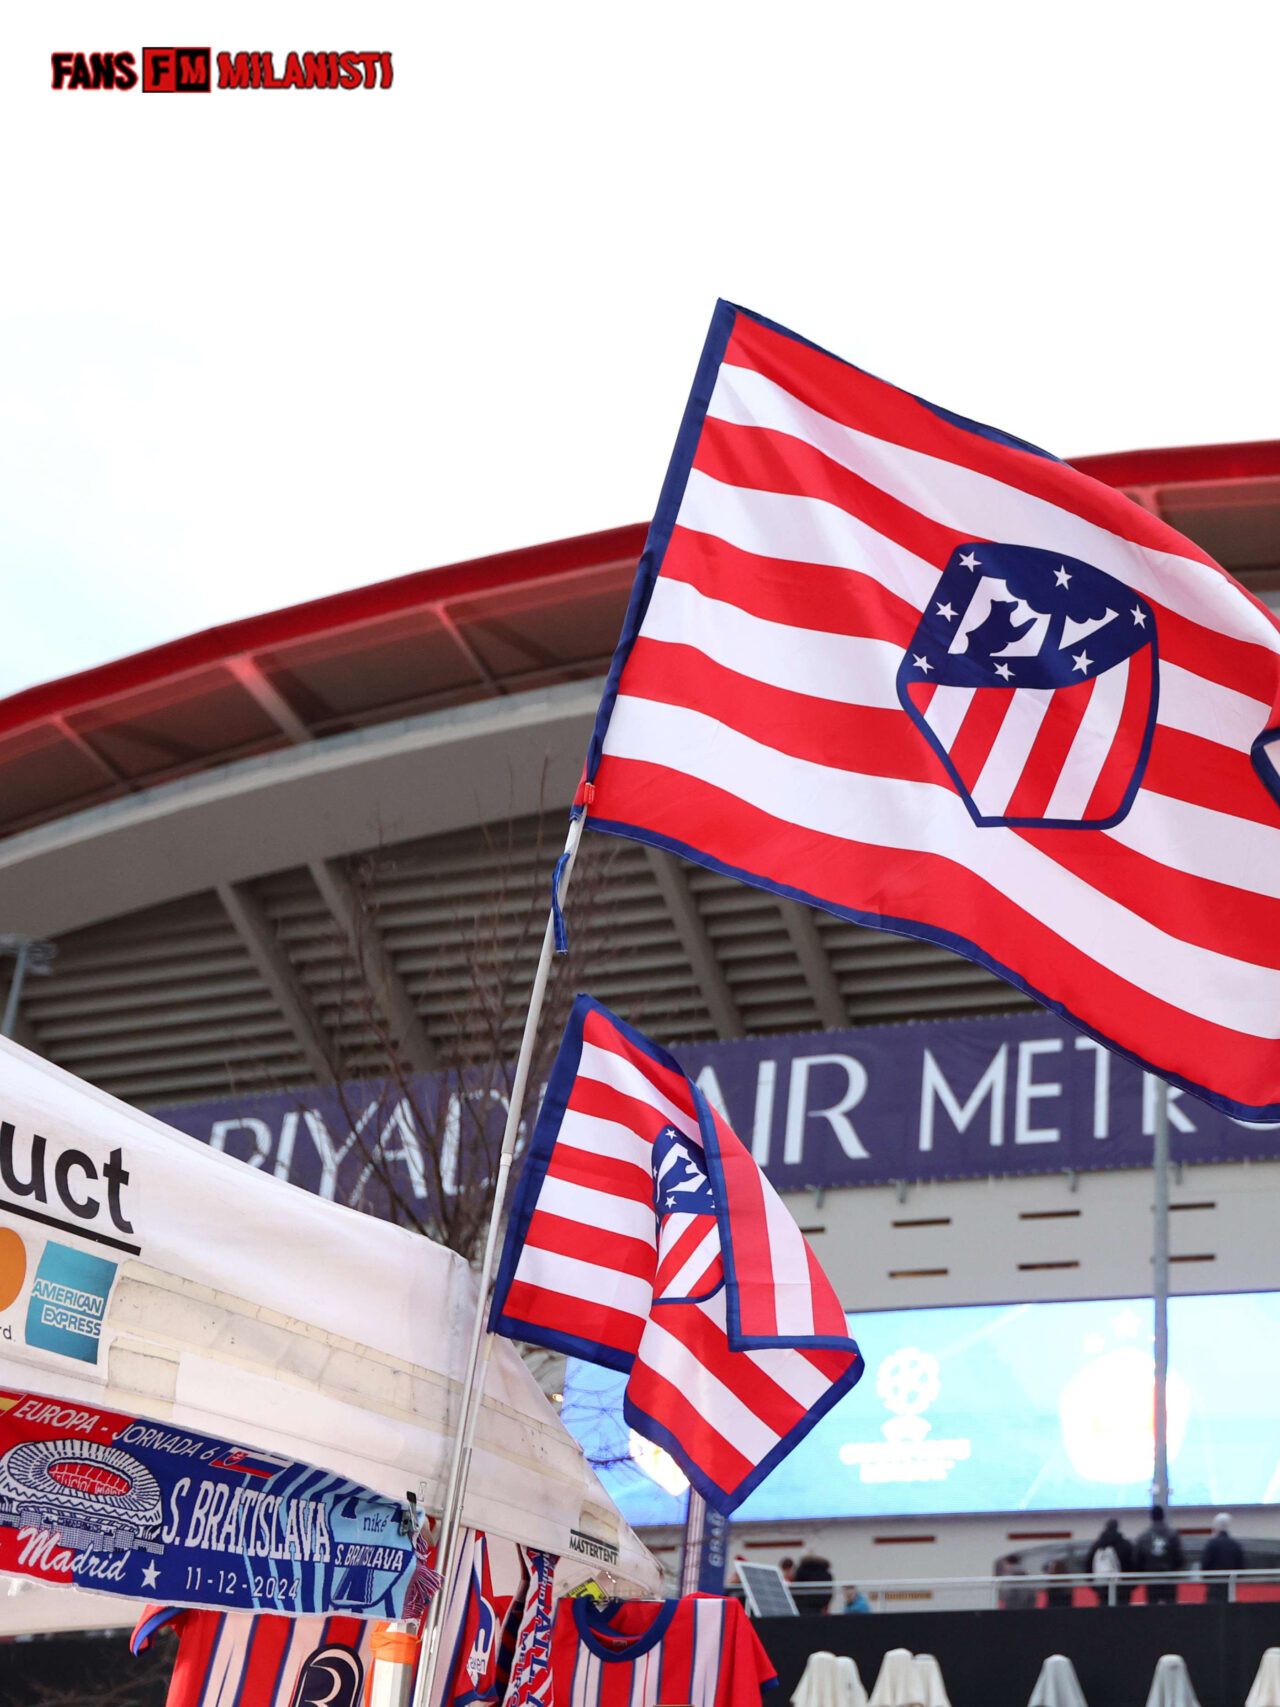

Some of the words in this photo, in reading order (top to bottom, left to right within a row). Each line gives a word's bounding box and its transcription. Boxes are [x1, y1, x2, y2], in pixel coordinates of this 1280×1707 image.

[32, 1279, 103, 1314] AMERICAN
[43, 1306, 101, 1337] EXPRESS
[13, 1400, 101, 1434] EUROPA
[112, 1424, 200, 1458] JORNADA
[200, 1447, 215, 1460] 6
[162, 1477, 191, 1545] S.
[185, 1480, 331, 1563] BRATISLAVA
[17, 1527, 131, 1581] Madrid
[569, 1536, 618, 1565] MASTERTENT
